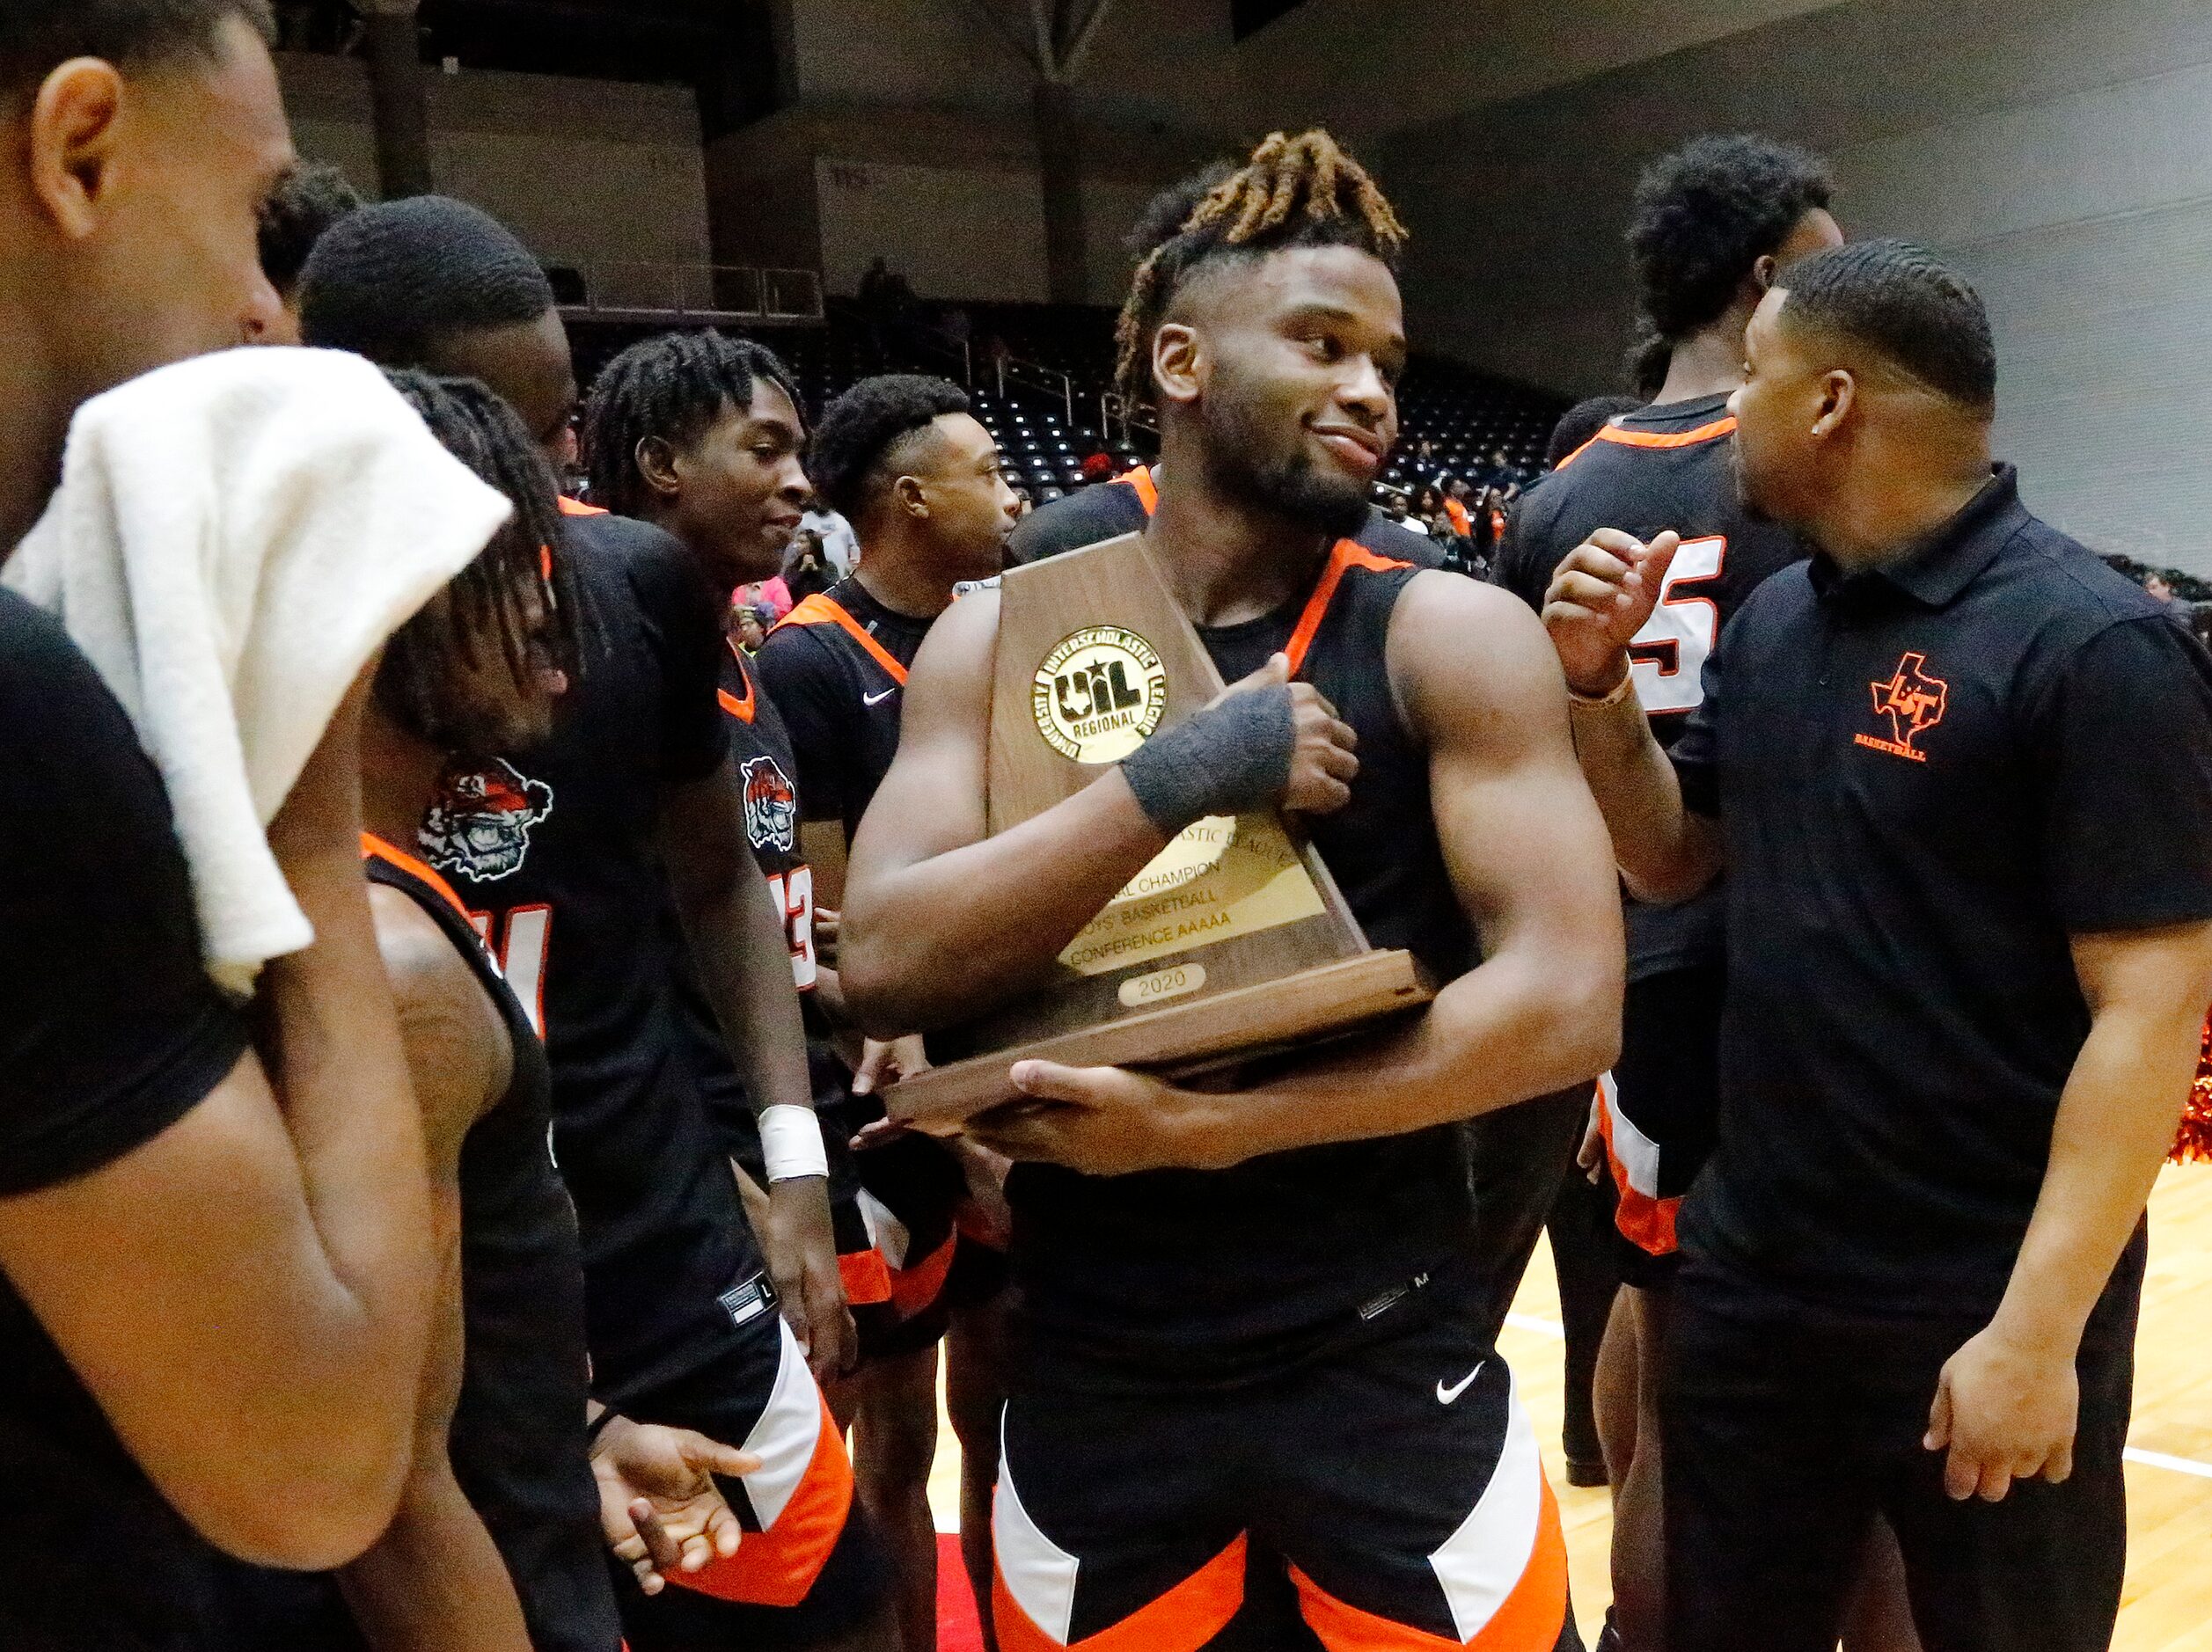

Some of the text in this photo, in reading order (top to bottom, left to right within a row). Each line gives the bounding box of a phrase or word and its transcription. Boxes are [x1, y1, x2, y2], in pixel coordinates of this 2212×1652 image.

[1043, 630, 1160, 676] INTERSCHOLASTIC
[1033, 683, 1080, 759] UNIVERSITY
[1073, 710, 1137, 740] REGIONAL
[1139, 860, 1221, 893] CHAMPION
[1123, 890, 1216, 925] BASKETBALL
[765, 864, 817, 992] 3
[1071, 911, 1232, 965] CONFERENCE AAAAA
[1139, 970, 1187, 998] 2020
